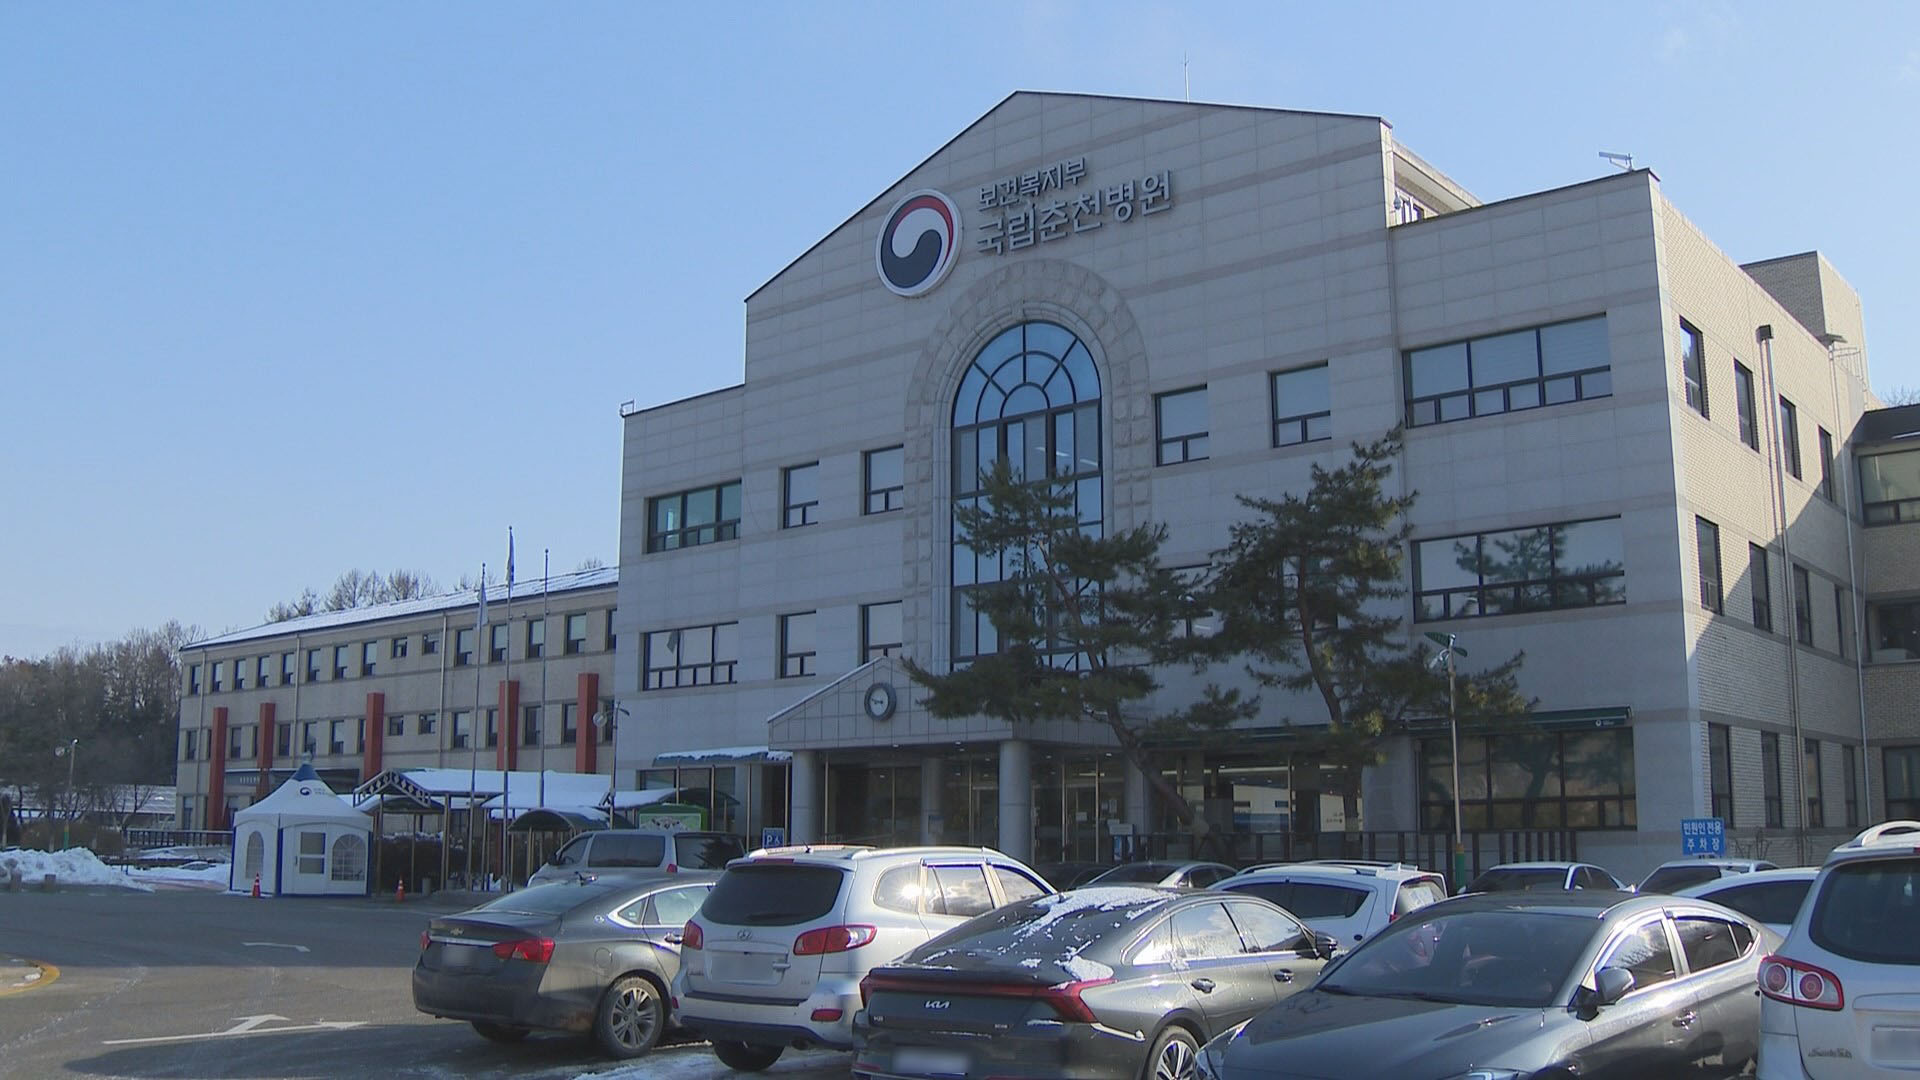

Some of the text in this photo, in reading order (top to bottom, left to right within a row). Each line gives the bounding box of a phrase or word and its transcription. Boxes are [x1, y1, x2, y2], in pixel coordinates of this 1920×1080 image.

[977, 169, 1173, 255] 국립춘천병원
[978, 157, 1086, 212] 보건복지부
[1683, 821, 1706, 836] 민원인
